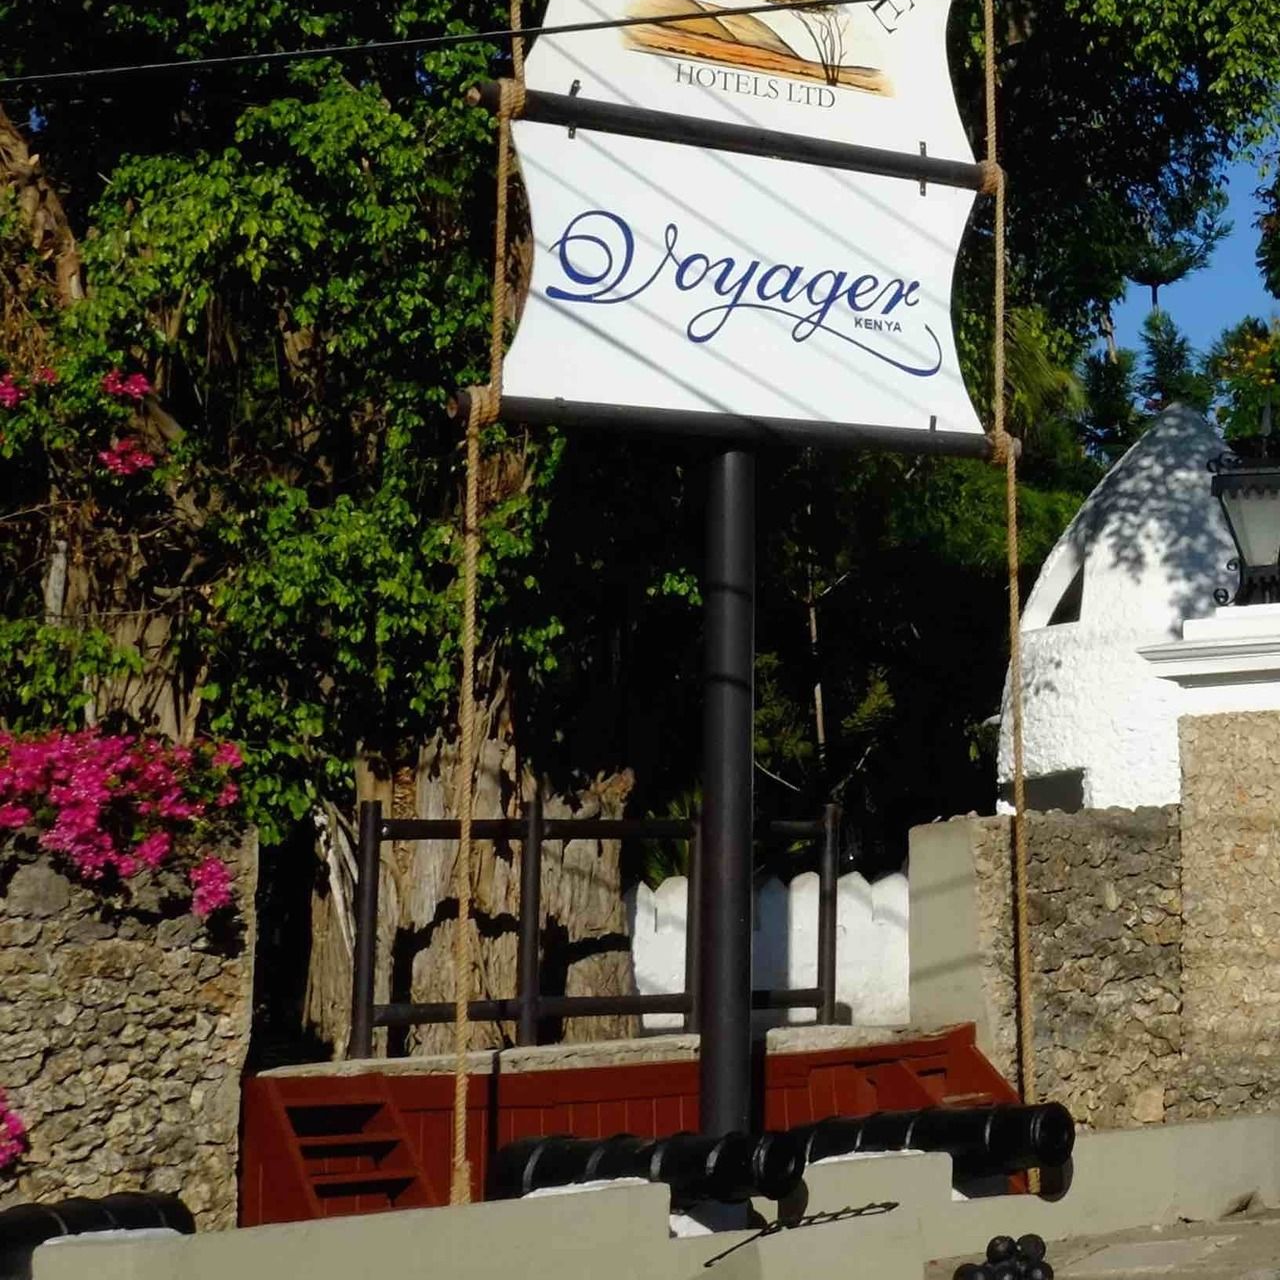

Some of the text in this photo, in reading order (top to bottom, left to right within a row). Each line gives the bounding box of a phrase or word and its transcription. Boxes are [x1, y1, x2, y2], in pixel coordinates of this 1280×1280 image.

[675, 63, 836, 109] HOTELS LTD
[545, 210, 942, 376] Voyager
[854, 318, 902, 333] KENYA
